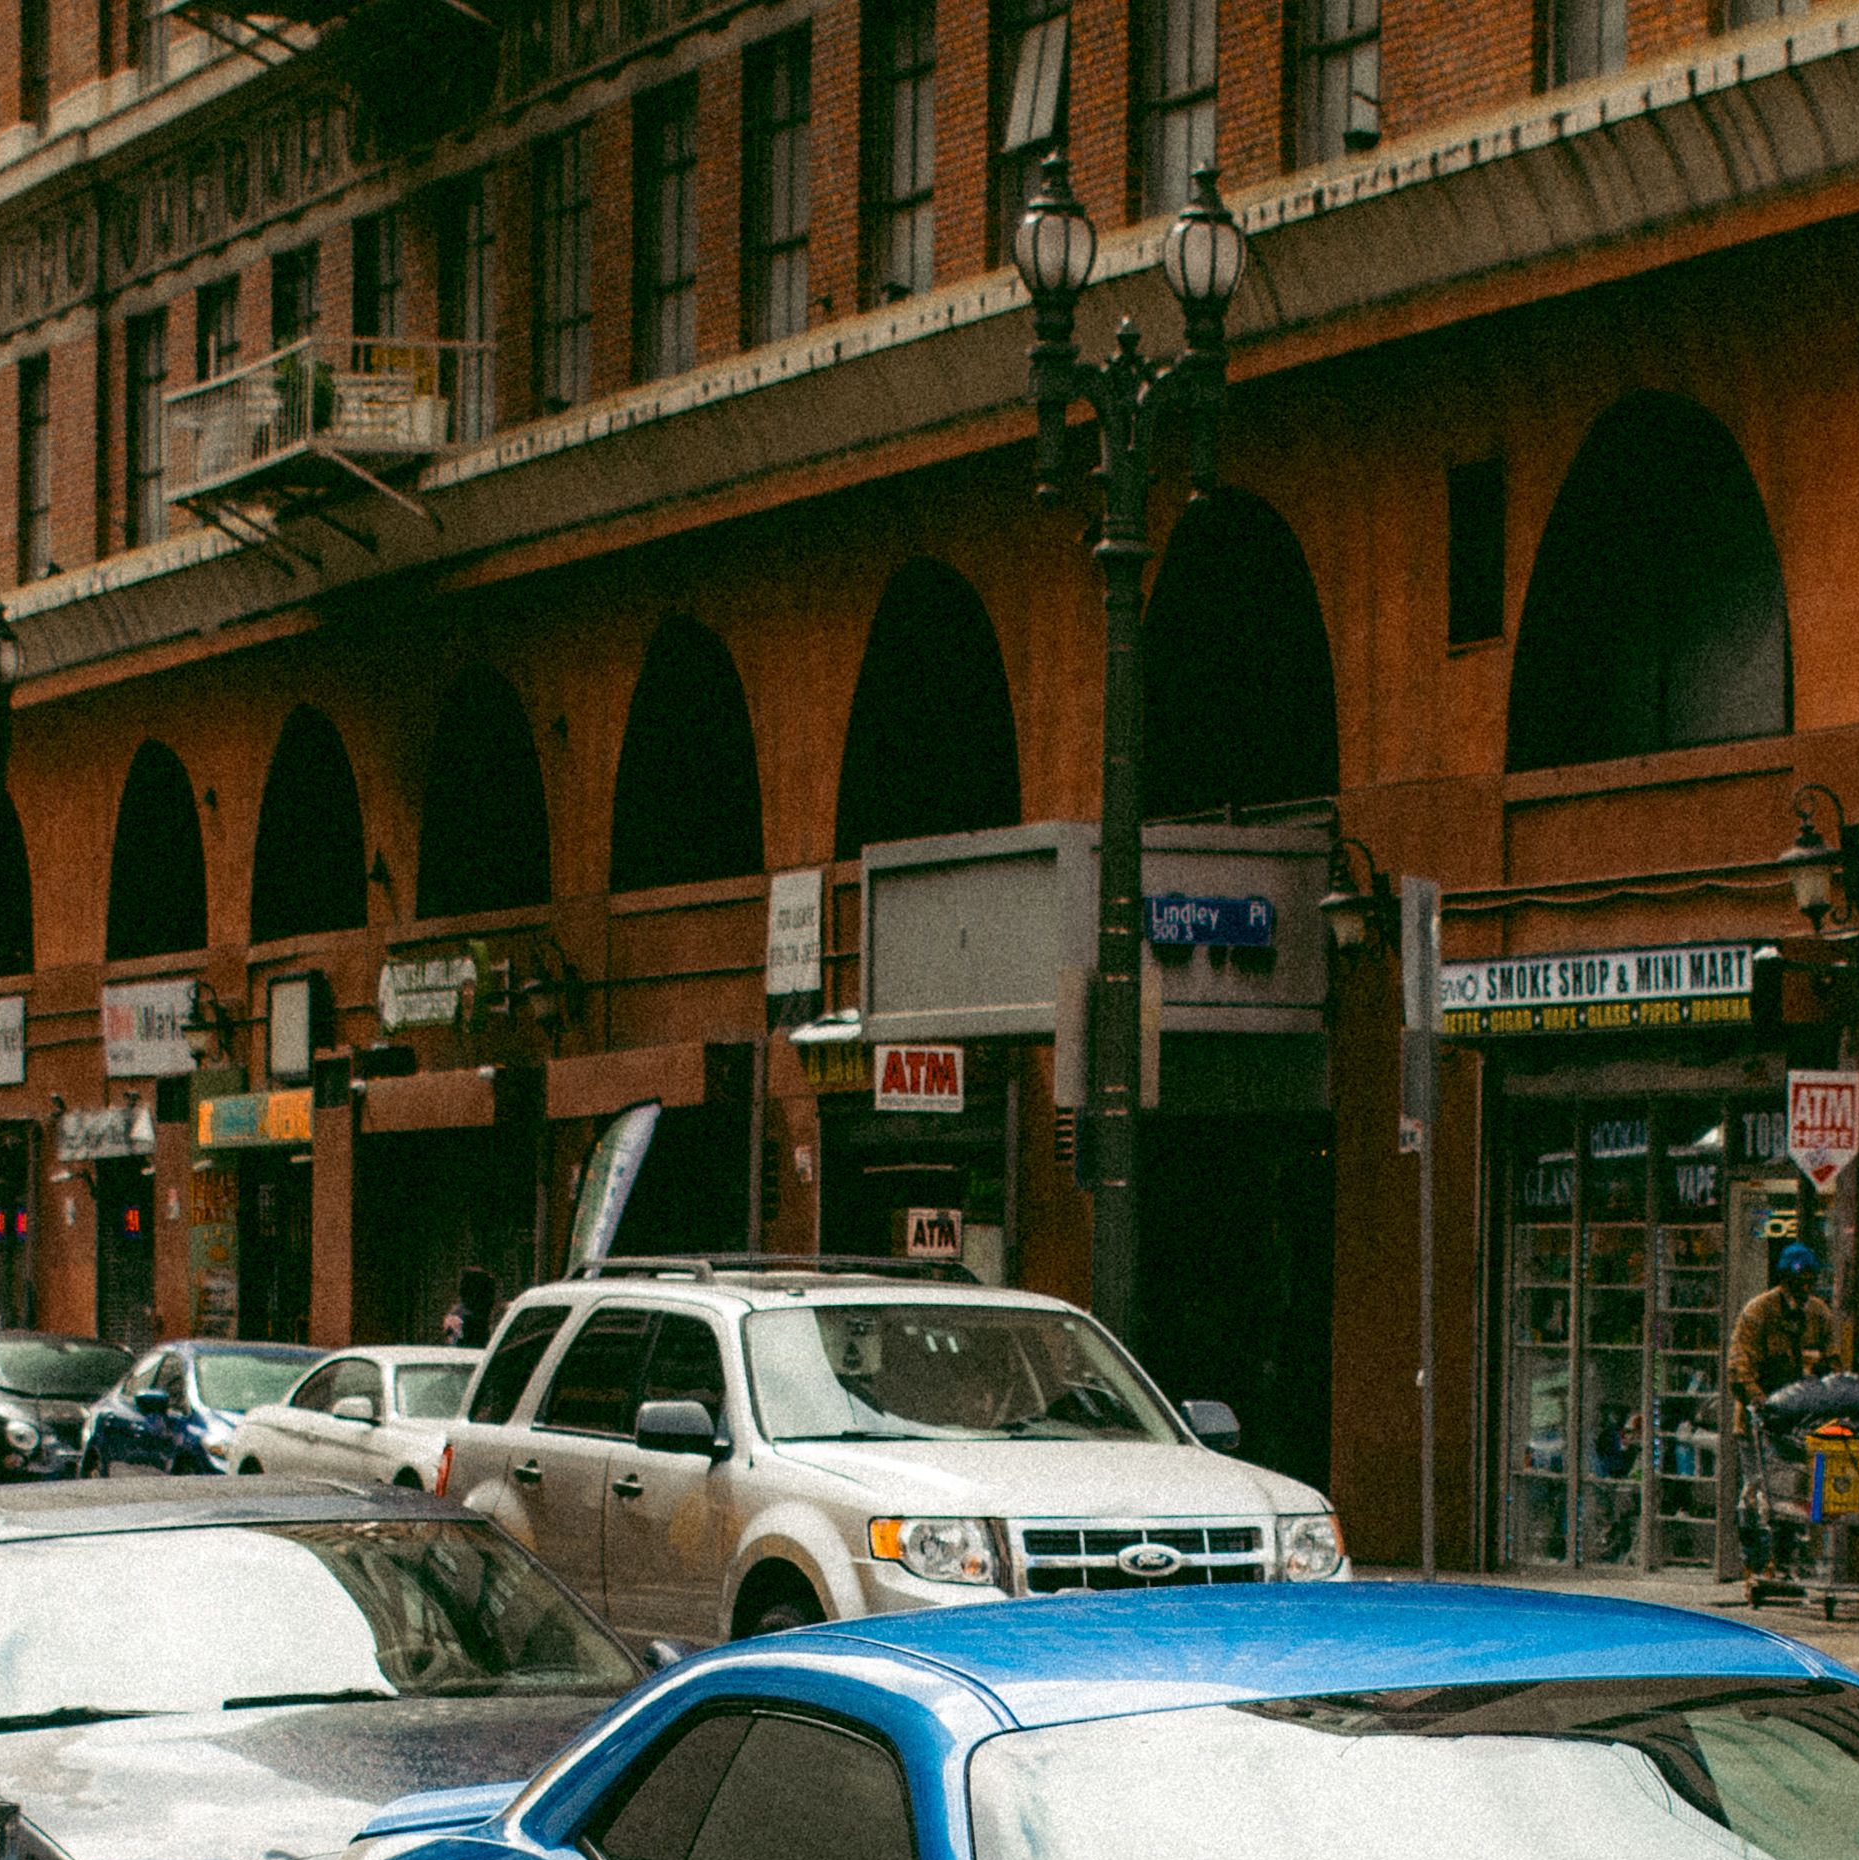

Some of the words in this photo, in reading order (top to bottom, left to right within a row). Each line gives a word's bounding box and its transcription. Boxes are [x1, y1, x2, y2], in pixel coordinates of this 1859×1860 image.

[1151, 900, 1220, 931] Lindley
[1152, 924, 1179, 941] 500
[1185, 925, 1194, 941] S
[1486, 963, 1553, 1001] SMOKE
[1559, 958, 1611, 996] SHOP
[1616, 962, 1630, 993] &
[1635, 953, 1683, 992] MINI
[1689, 949, 1748, 990] MART
[1490, 1008, 1533, 1032] CIGAR
[1542, 1006, 1578, 1030] VAPE
[1586, 1003, 1631, 1028] GLASS
[1640, 1000, 1681, 1025] PIPES
[880, 1050, 959, 1096] ATM
[1794, 1088, 1854, 1129] ATM
[1794, 1130, 1854, 1149] HERE
[912, 1218, 957, 1250] ATM
